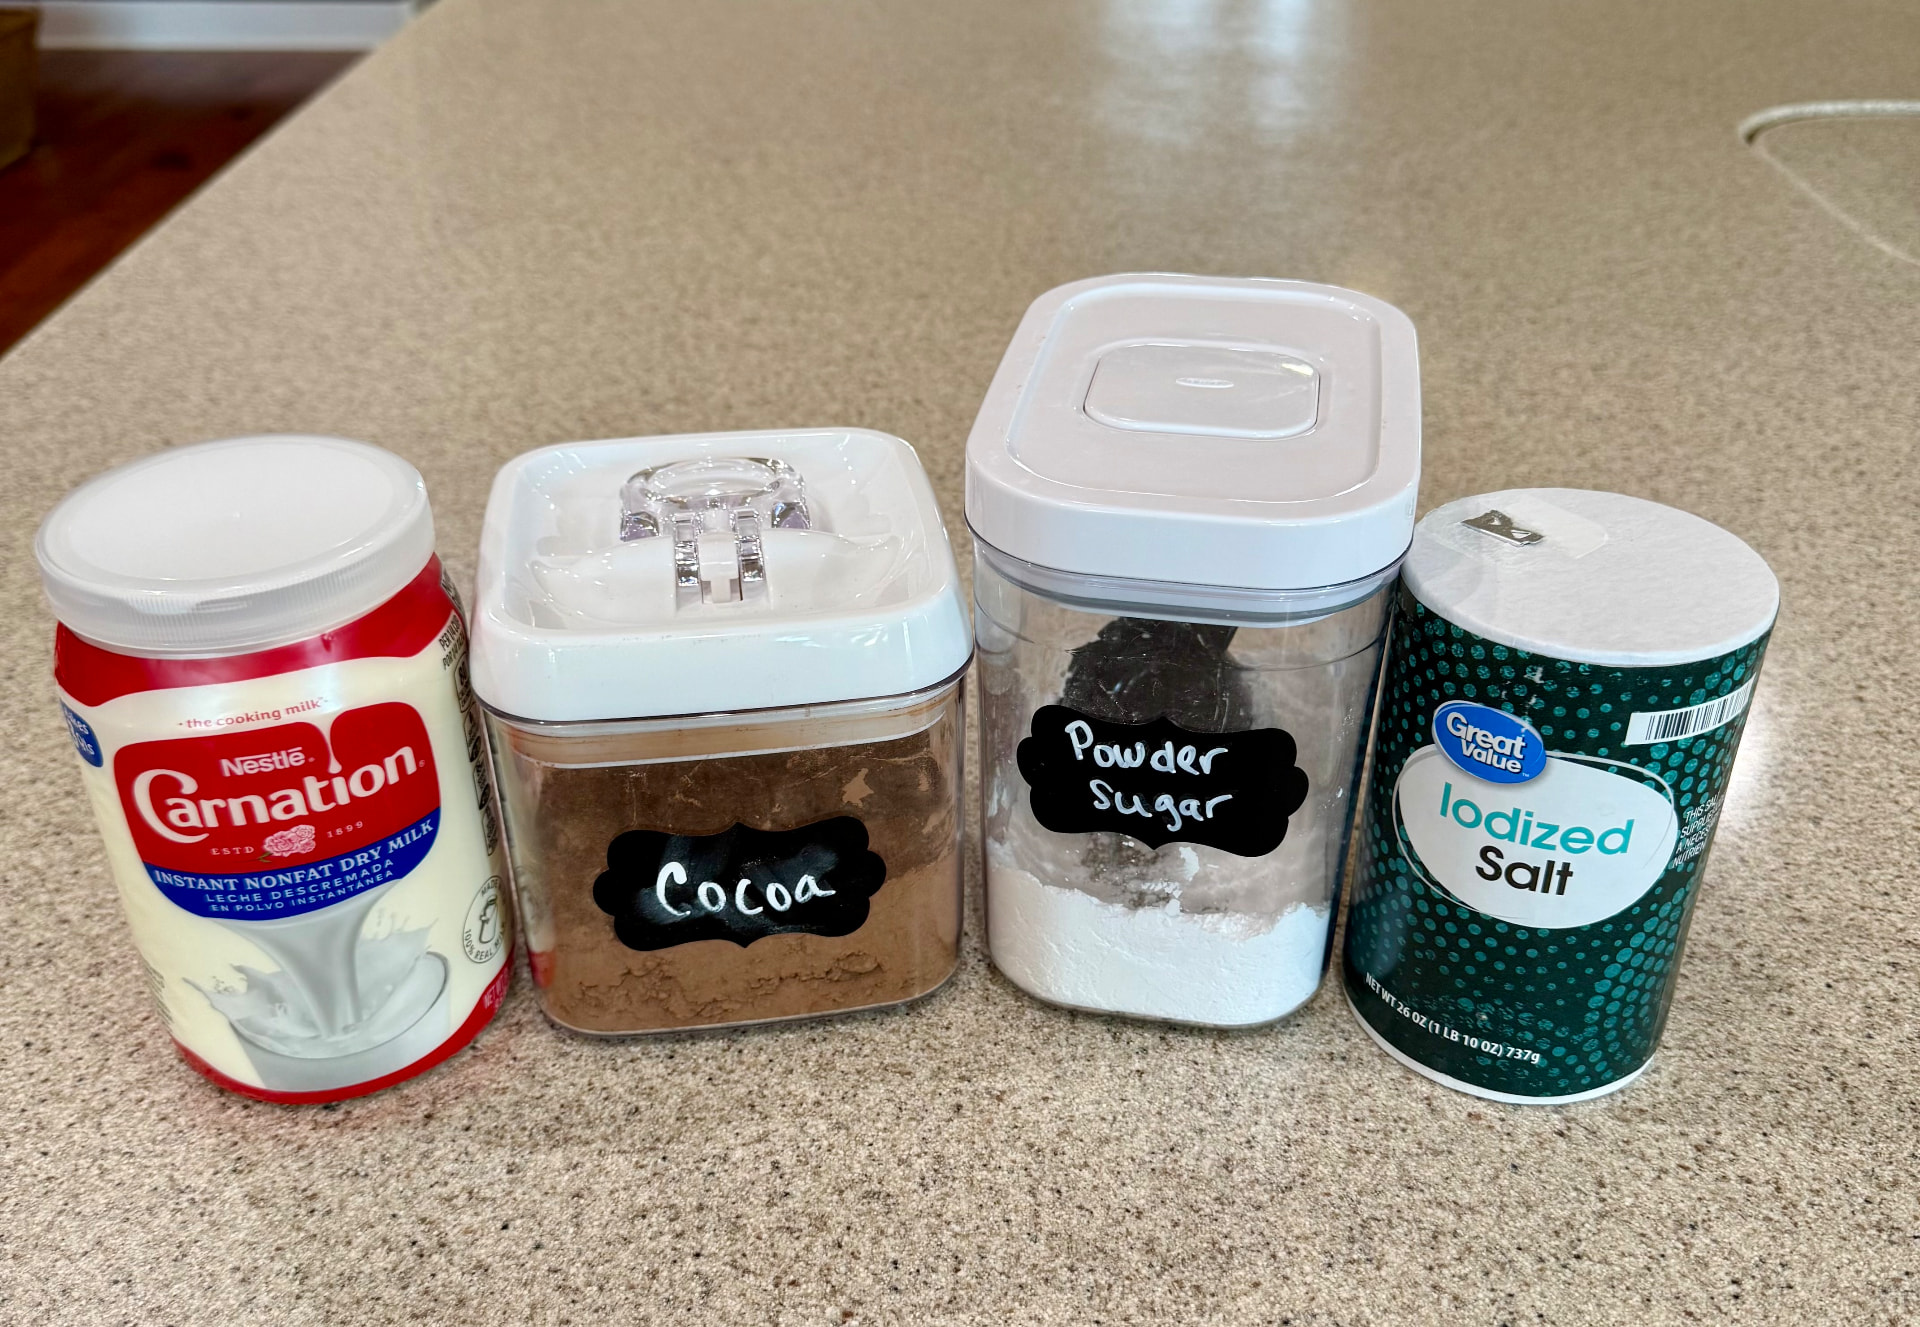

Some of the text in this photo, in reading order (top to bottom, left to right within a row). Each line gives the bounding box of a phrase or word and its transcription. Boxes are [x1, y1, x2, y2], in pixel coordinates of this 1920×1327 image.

[187, 698, 321, 729] the cooking milk
[1445, 710, 1527, 760] Great
[1064, 720, 1228, 775] Powder
[1461, 738, 1522, 774] Value
[132, 745, 417, 844] Carnation
[1439, 782, 1635, 855] Iodized
[153, 818, 434, 891] INSTANT NONFAT DRY MILK
[211, 820, 364, 856] ESTD 1899
[1672, 840, 1706, 868] NUTRIEN
[205, 858, 394, 903] LECHE DESCREMADA
[655, 861, 836, 916] Cocoa
[1475, 845, 1573, 896] Salt
[210, 904, 230, 912] EN
[235, 901, 285, 912] POLVO
[474, 948, 493, 961] REAL
[1365, 972, 1541, 1065] NET WT 26 OZ (1 LB 10 OZ) 737g
